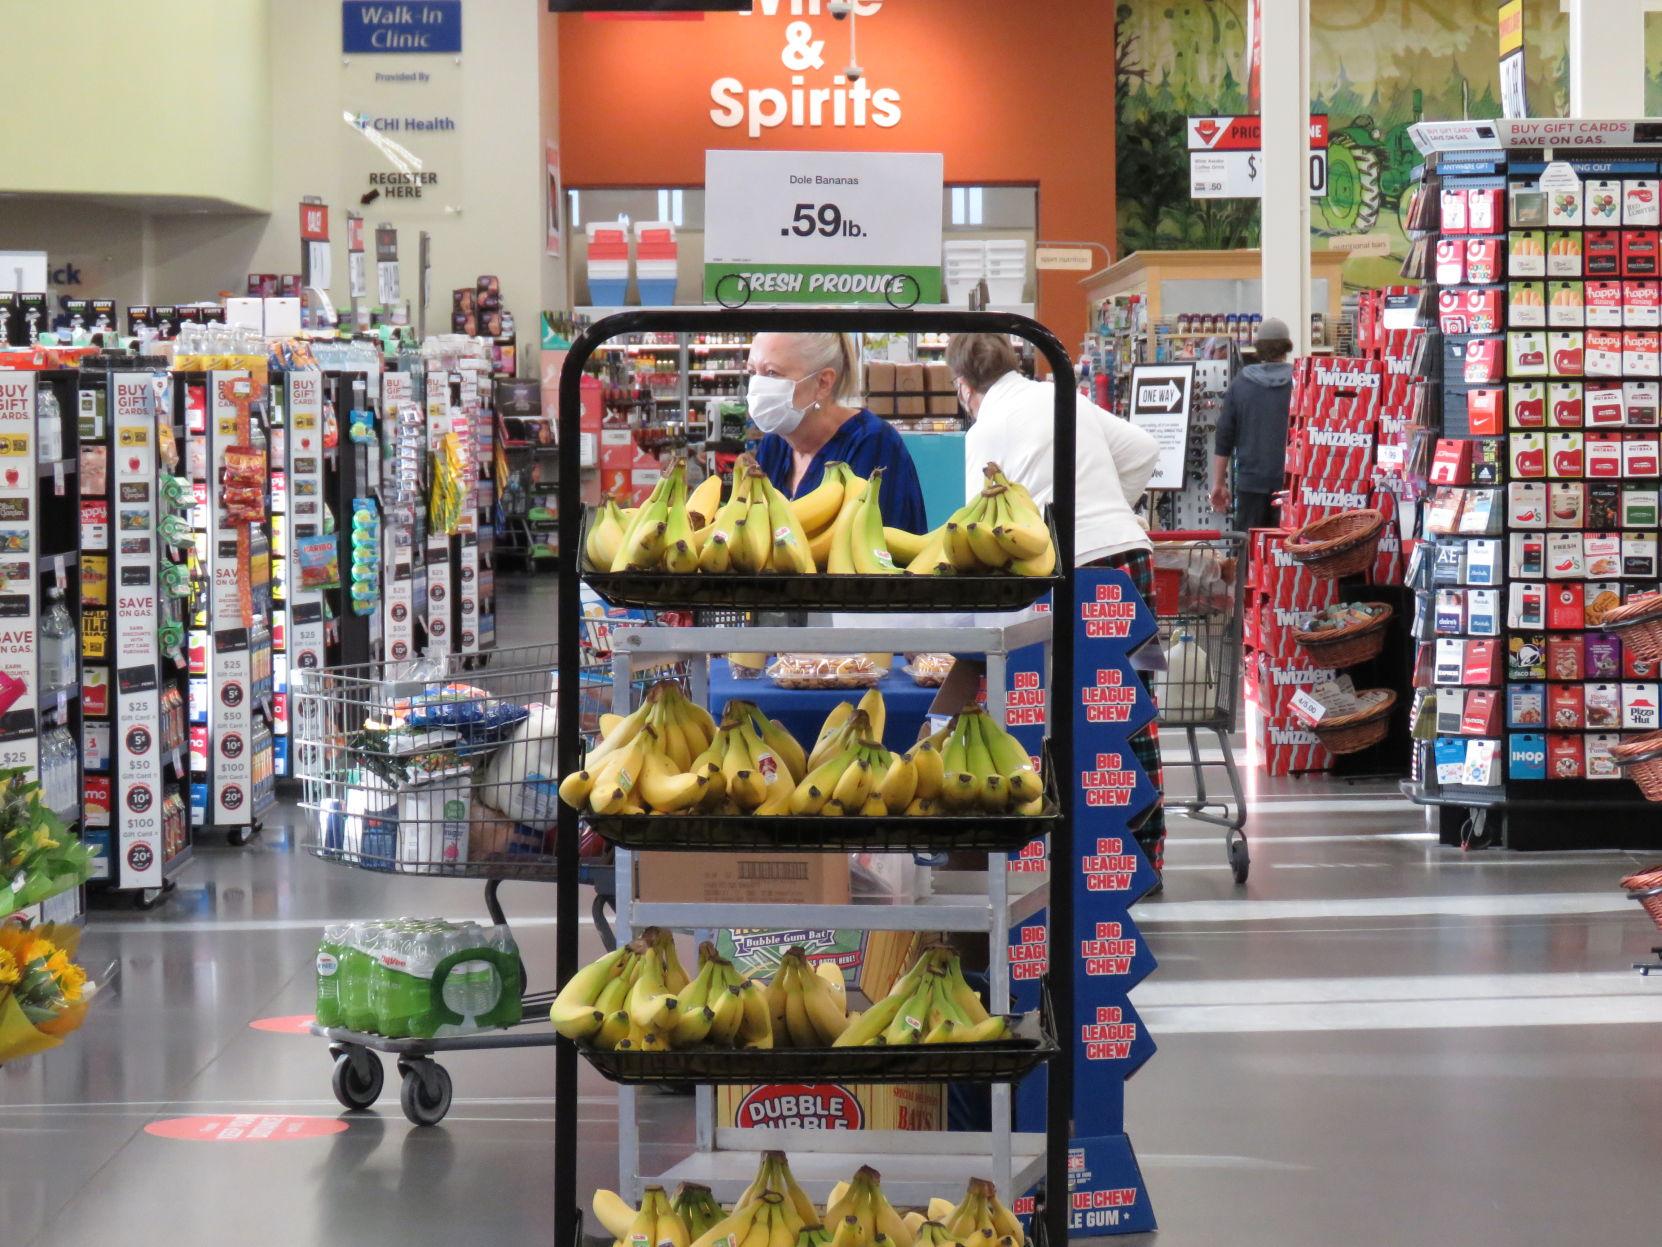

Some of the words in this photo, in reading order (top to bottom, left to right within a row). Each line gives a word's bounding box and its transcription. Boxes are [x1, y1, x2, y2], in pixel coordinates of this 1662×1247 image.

[371, 29, 430, 48] Clinic
[781, 21, 825, 70] &
[375, 72, 415, 82] Provided
[418, 73, 430, 83] By
[709, 75, 902, 137] Spirits
[374, 118, 400, 131] CHI
[404, 117, 455, 131] Health
[1511, 124, 1540, 134] BUY
[1544, 123, 1575, 133] GIFT
[1580, 122, 1631, 132] CARDS.
[1231, 127, 1261, 139] PRIC
[1511, 136, 1546, 145] SAVE
[1549, 136, 1570, 145] ON
[1574, 135, 1607, 144] GAS.
[1592, 164, 1612, 172] OUT
[369, 172, 437, 184] REGISTER
[789, 175, 811, 185] Dole
[815, 175, 859, 185] Bananas
[385, 187, 422, 198] HERE
[738, 273, 803, 292] FRESH
[809, 274, 906, 293] PRODUCE
[1587, 286, 1621, 300] happy
[1625, 286, 1658, 300] happy
[1587, 335, 1621, 348] happy
[1624, 335, 1658, 348] happy
[293, 381, 316, 390] BUY
[1314, 367, 1381, 388] Twizzlers
[118, 384, 147, 396] BUY
[1142, 388, 1157, 403] ONE
[1158, 388, 1174, 402] WAY
[118, 397, 147, 407] GIFT
[1, 412, 30, 420] ARDS.
[1307, 426, 1373, 447] Twizzlers
[1301, 486, 1368, 508] Twizzlers
[216, 569, 238, 578] SAV
[1096, 585, 1122, 602] BIG
[119, 597, 153, 609] SAVE
[1082, 602, 1136, 620] LEAGUE
[1086, 620, 1131, 637] CHEW
[223, 661, 241, 669] $25
[1014, 672, 1040, 690] BIG
[1096, 669, 1122, 686] BIG
[1269, 667, 1337, 686] Twizzlers
[1010, 689, 1045, 707] EAGU
[1082, 686, 1136, 704] LEAGUE
[128, 702, 149, 712] $25
[1086, 704, 1131, 721] CHEW
[1631, 707, 1655, 716] Pizza
[223, 712, 242, 720] $50
[1006, 707, 1046, 726] CHEW
[1631, 714, 1651, 724] Hut
[1268, 727, 1320, 745] Twizzle
[3, 752, 27, 763] $25
[129, 760, 150, 770] $50
[1096, 753, 1122, 770] BIG
[221, 764, 245, 772] $100
[1082, 770, 1136, 788] LEAGUE
[84, 790, 107, 800] mc
[1086, 788, 1131, 805] CHEW
[127, 819, 154, 828] $100
[1096, 838, 1122, 855] BIG
[1082, 855, 1136, 873] LEAGUE
[1086, 873, 1131, 890] CHEW
[746, 936, 780, 947] Bubble
[783, 933, 806, 942] Gum
[808, 930, 826, 939] Bat
[1021, 926, 1046, 944] BIG
[1096, 922, 1122, 939] BIG
[1082, 939, 1136, 957] LEAGUE
[1086, 957, 1131, 974] CHEW
[1096, 1006, 1122, 1023] BIG
[1082, 1023, 1136, 1041] LEAGUE
[1086, 1041, 1131, 1058] CHEW
[749, 1095, 844, 1121] DUBBLE
[1014, 1197, 1035, 1215] BIG
[1093, 1188, 1137, 1208] CHEW
[1086, 1210, 1119, 1227] GUM
